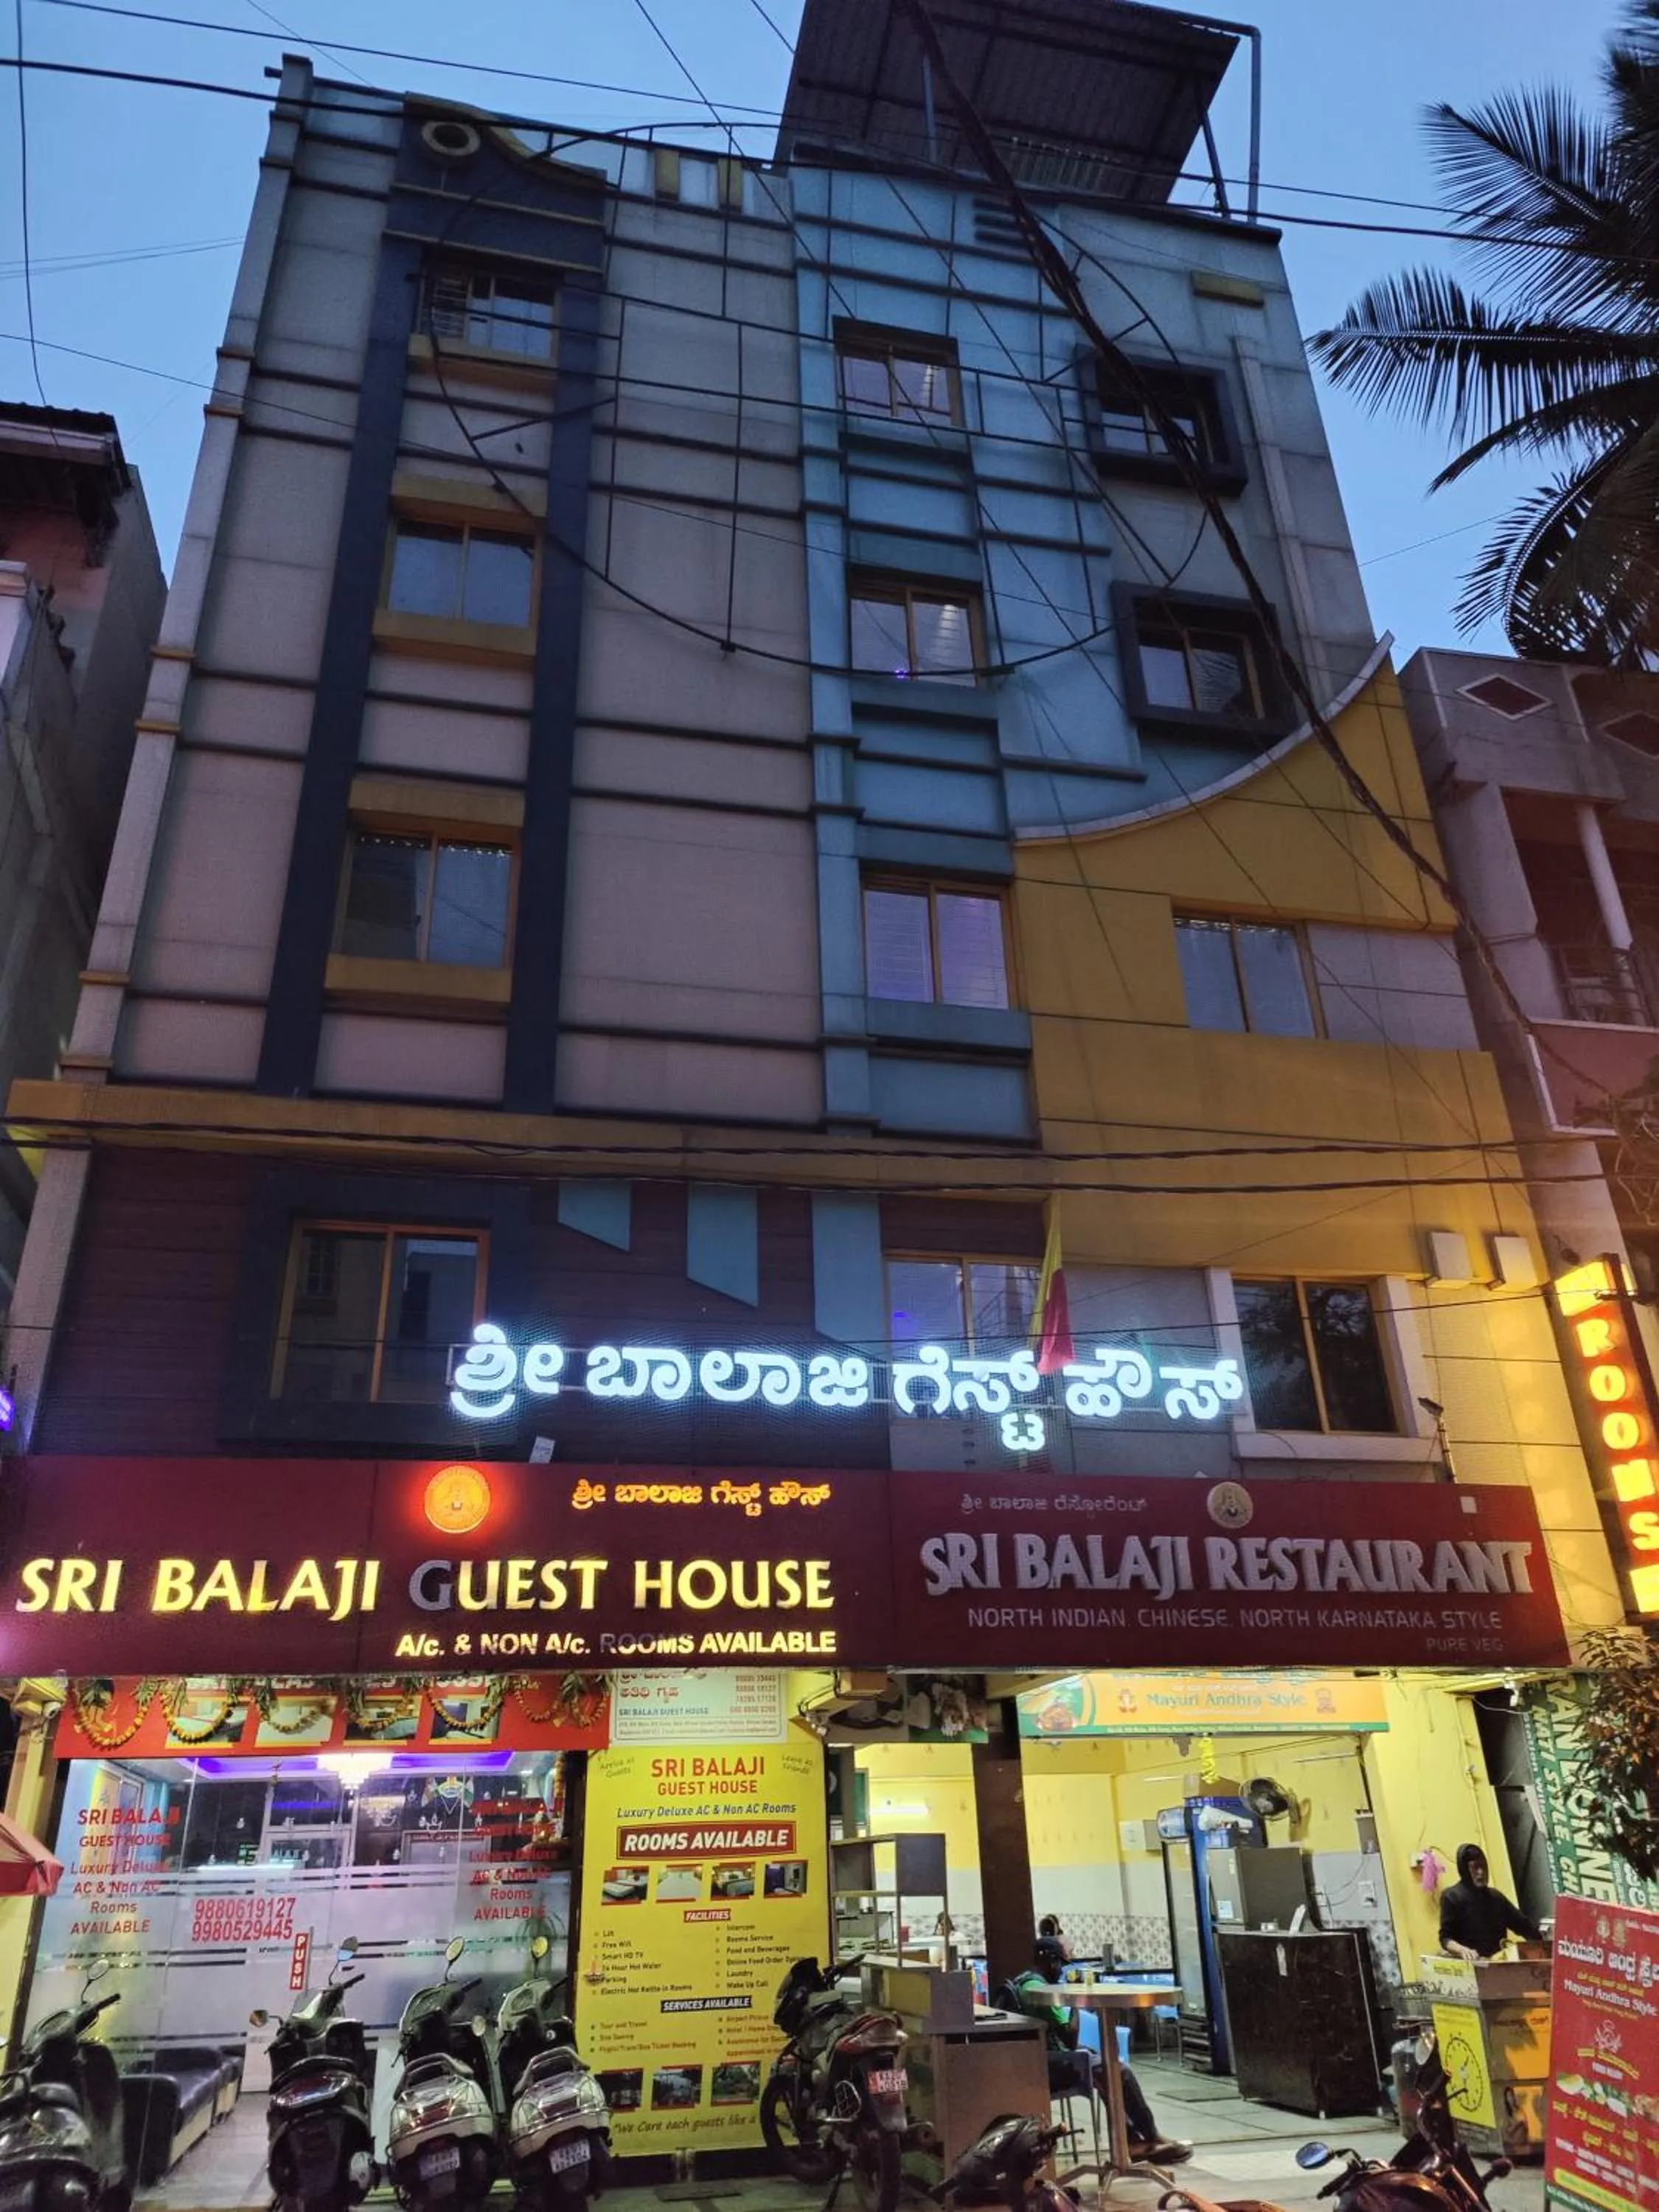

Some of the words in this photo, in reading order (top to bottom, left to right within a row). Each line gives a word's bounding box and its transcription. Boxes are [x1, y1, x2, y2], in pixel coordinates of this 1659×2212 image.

[450, 1324, 564, 1418] ಶ್ರೀ
[587, 1346, 869, 1408] ಬಾಲಾಜಿ
[892, 1346, 1045, 1451] ಗೆಸ್ಟ್
[571, 1478, 605, 1509] ಶ್ರೀ
[614, 1484, 702, 1504] ಬಾಲಾಜಿ
[769, 1481, 830, 1506] ಹೌಸ್
[961, 1493, 984, 1514] ಶ್ರೀ
[919, 1533, 1001, 1596] SRI
[1013, 1534, 1194, 1601] BALAJI
[1204, 1537, 1534, 1594] RESTAURANT
[16, 1559, 122, 1613] SRI
[151, 1559, 380, 1621] BALAJI
[409, 1559, 608, 1610] GUEST
[634, 1559, 835, 1609] HOUSE
[968, 1608, 1043, 1627] NORTH
[1240, 1609, 1310, 1628] NORTH
[1317, 1610, 1436, 1629] KARNATAKA
[1443, 1611, 1503, 1629] STYLE
[454, 1635, 470, 1655] &
[481, 1633, 538, 1655] NON
[600, 1634, 693, 1654] ROOMS
[699, 1632, 836, 1653] AVAILABLE
[1427, 1638, 1467, 1652] PURE
[1470, 1638, 1503, 1652] VEG
[651, 1758, 685, 1778] SRI
[692, 1756, 765, 1777] BALAJI
[658, 1781, 705, 1795] GUEST
[710, 1780, 757, 1794] HOUSE
[77, 1808, 107, 1825] SRI
[617, 1806, 655, 1819] Luxury
[657, 1806, 694, 1817] Deluxe
[695, 1805, 710, 1815] AC
[713, 1805, 720, 1815] &
[723, 1804, 744, 1814] Non
[745, 1804, 759, 1813] AC
[762, 1803, 797, 1813] Rooms
[80, 1834, 119, 1846] GUEST
[119, 1833, 172, 1846] HOUSE
[625, 1833, 689, 1851] ROOMS
[690, 1829, 789, 1849] AVAILABLE
[71, 1862, 118, 1876] Luxury
[73, 1882, 91, 1893] AC
[97, 1882, 105, 1893] &
[111, 1882, 136, 1893] Non
[490, 1888, 533, 1900] Rooms
[90, 1900, 137, 1913] Rooms
[195, 1897, 296, 1919] 9880619127
[686, 1911, 729, 1921] FACILITIES
[71, 1919, 150, 1935] AVAILABLE
[192, 1919, 293, 1941] 9980529445
[292, 1935, 306, 1989] PUSH
[664, 1999, 703, 2011] SERVICES
[704, 1997, 750, 2008] AVAILABLE
